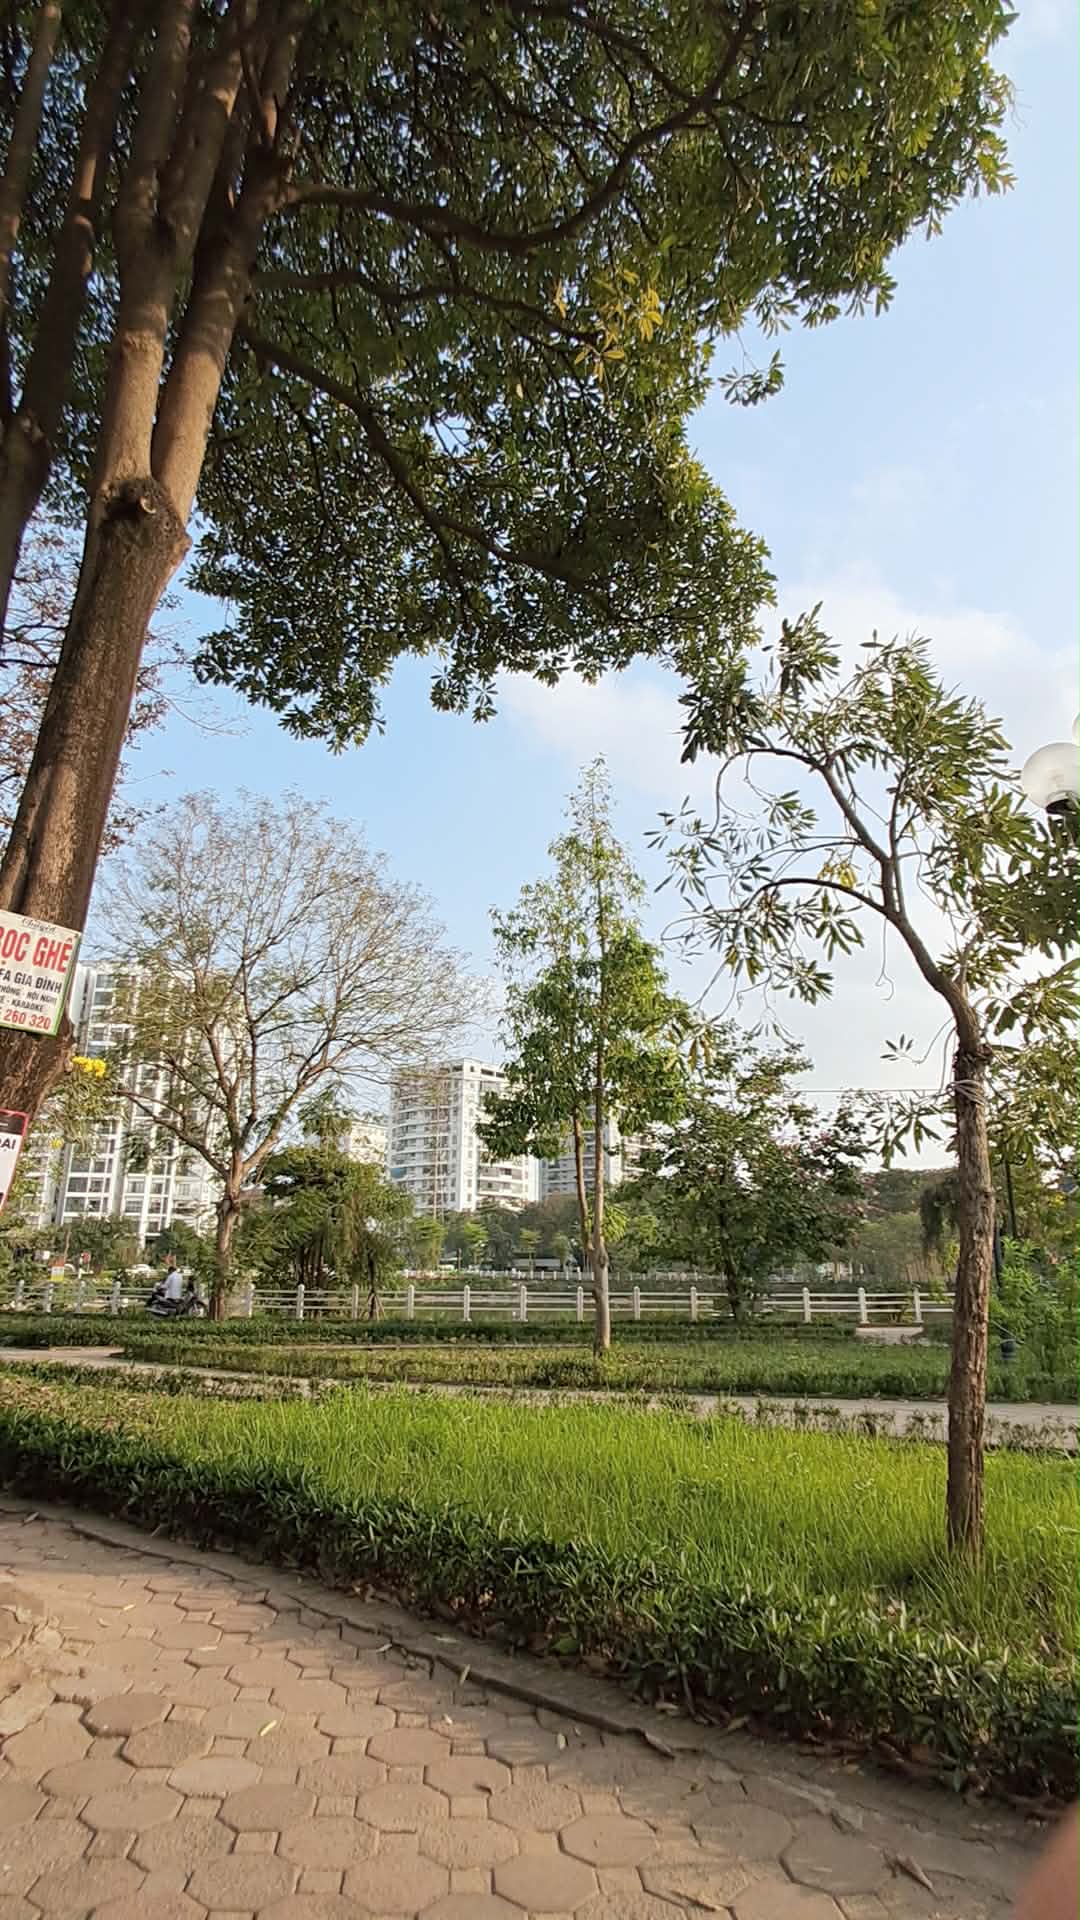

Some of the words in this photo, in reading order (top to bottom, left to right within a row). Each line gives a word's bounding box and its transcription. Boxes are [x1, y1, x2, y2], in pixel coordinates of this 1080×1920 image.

[0, 984, 20, 996] HÒNG
[14, 972, 32, 987] GIA
[35, 976, 62, 993] ĐÌNH
[11, 999, 45, 1013] KARAOKE
[3, 1008, 26, 1024] 260
[29, 1013, 51, 1030] 320
[0, 1136, 16, 1152] ẠI
